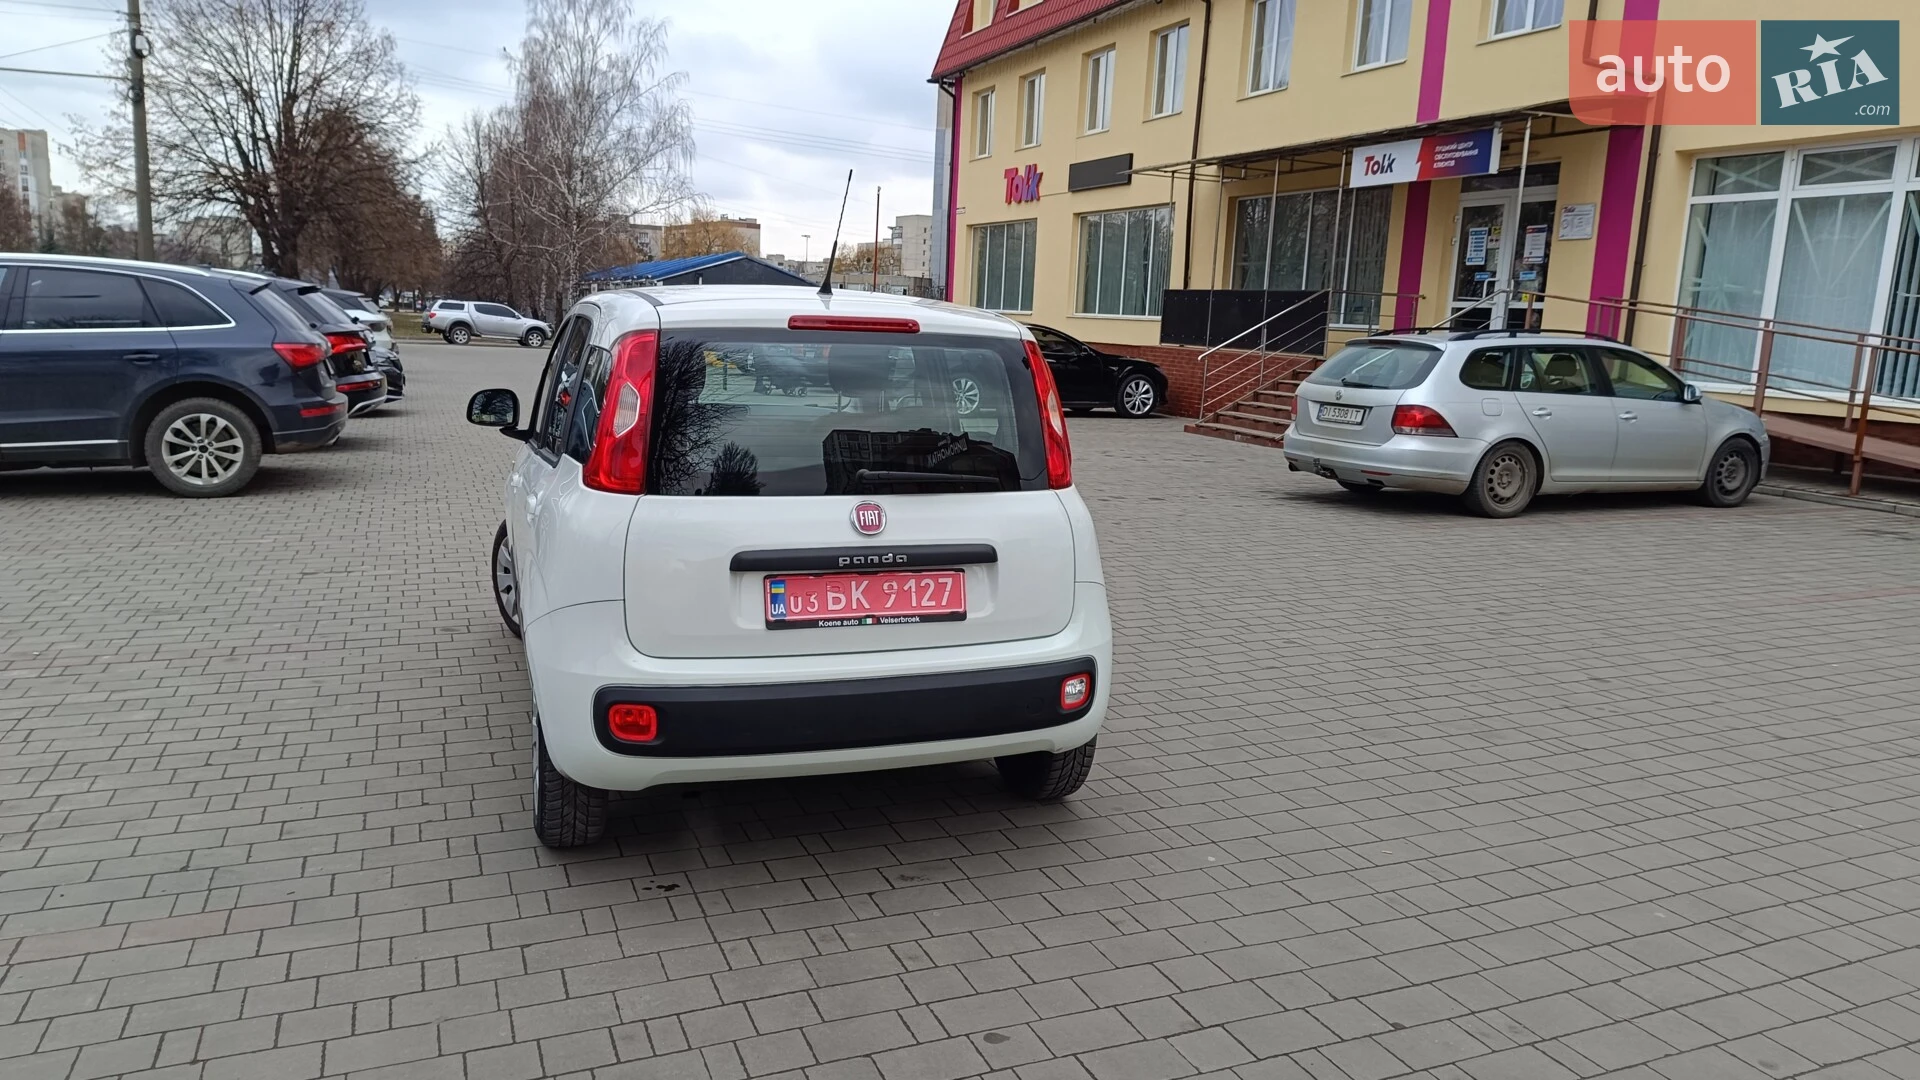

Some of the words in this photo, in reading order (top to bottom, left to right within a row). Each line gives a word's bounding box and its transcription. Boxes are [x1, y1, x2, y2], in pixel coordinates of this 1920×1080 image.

[1331, 408, 1349, 419] 5308
[859, 510, 879, 526] FIAT
[838, 553, 907, 567] panda
[882, 577, 953, 608] 9127
[771, 604, 786, 615] UA
[880, 616, 920, 624] Velserbroek
